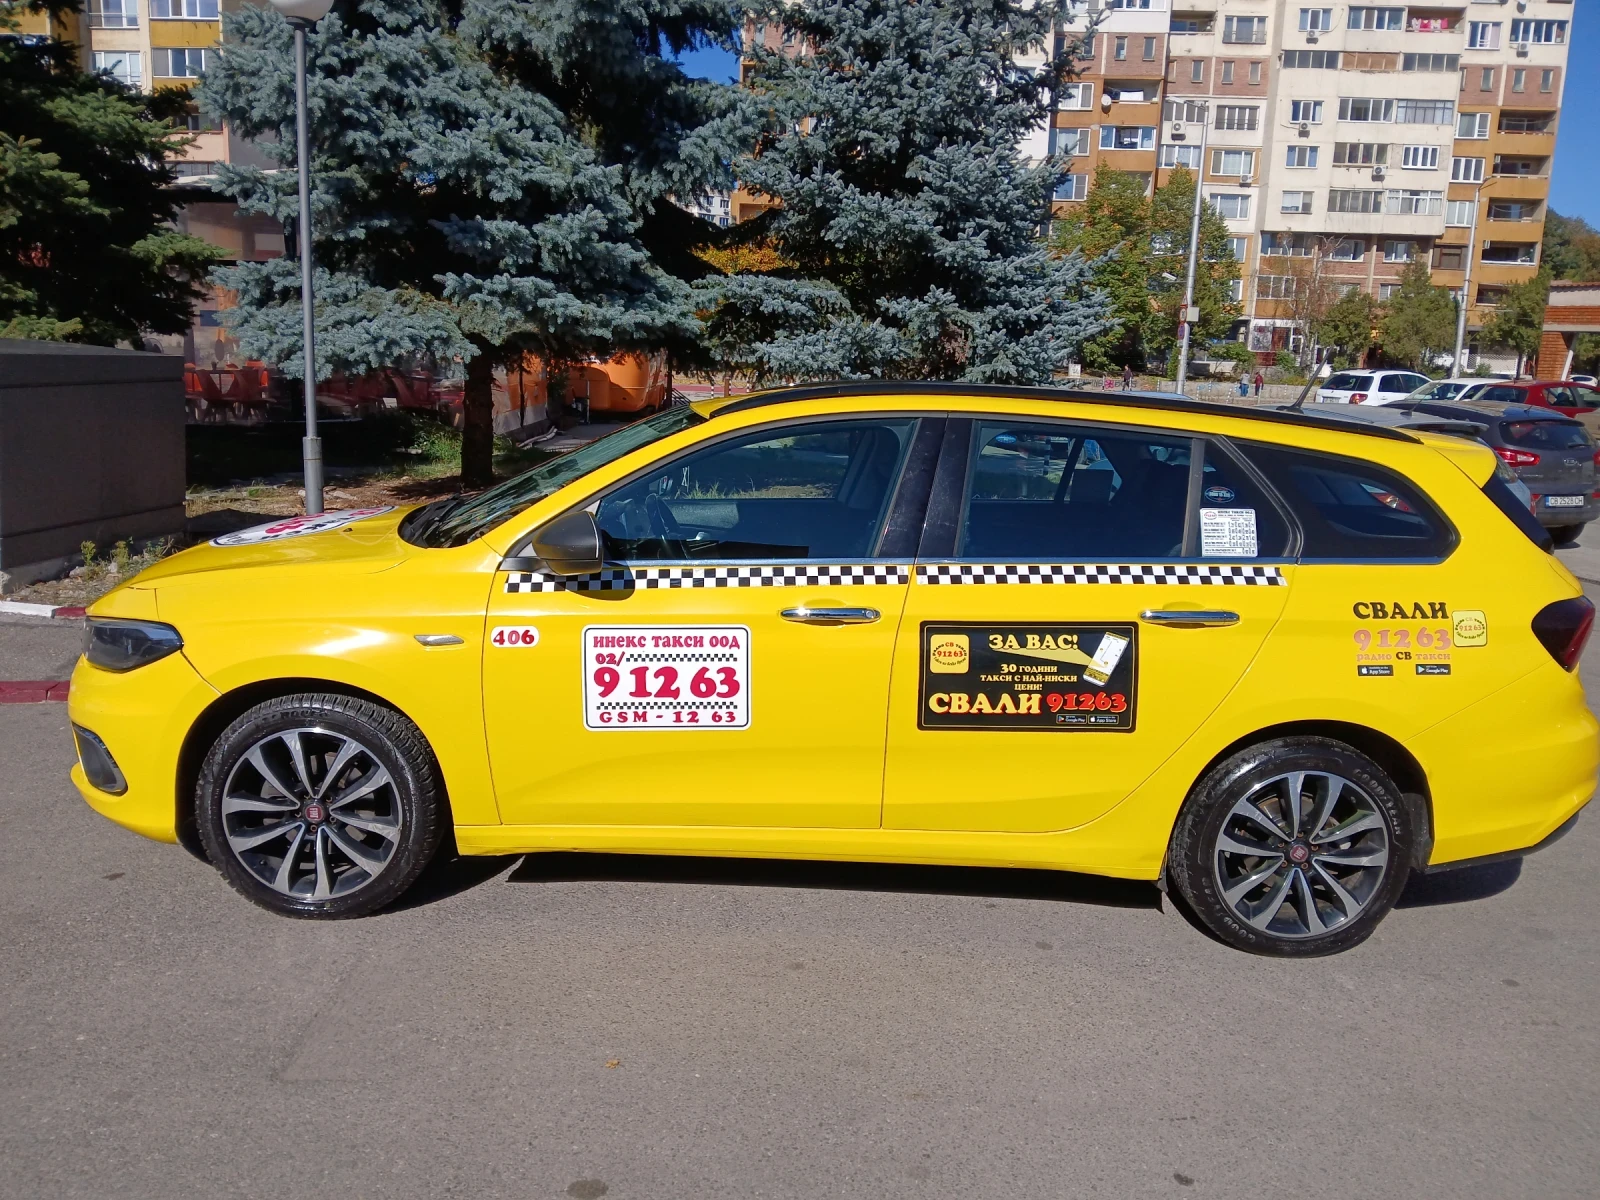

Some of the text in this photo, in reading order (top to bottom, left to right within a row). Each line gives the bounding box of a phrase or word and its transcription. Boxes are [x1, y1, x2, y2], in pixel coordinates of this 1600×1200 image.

[1353, 602, 1449, 620] СВАЛИ
[493, 630, 535, 645] 406
[652, 636, 704, 648] такси
[988, 634, 1079, 650] ЗА ВАС!
[1353, 626, 1452, 651] 9 12 63
[595, 651, 625, 666] 02/
[1395, 651, 1412, 660] СВ
[1000, 664, 1058, 674] 30 ГОДИНИ
[594, 666, 740, 700] 9 12 63
[980, 674, 1012, 682] ТАКСИ
[1014, 674, 1021, 682] С
[929, 692, 1042, 715] СВАЛИ
[1046, 691, 1127, 713] 91263
[599, 711, 648, 723] GSM
[672, 711, 699, 723] 12
[711, 711, 736, 723] 63
